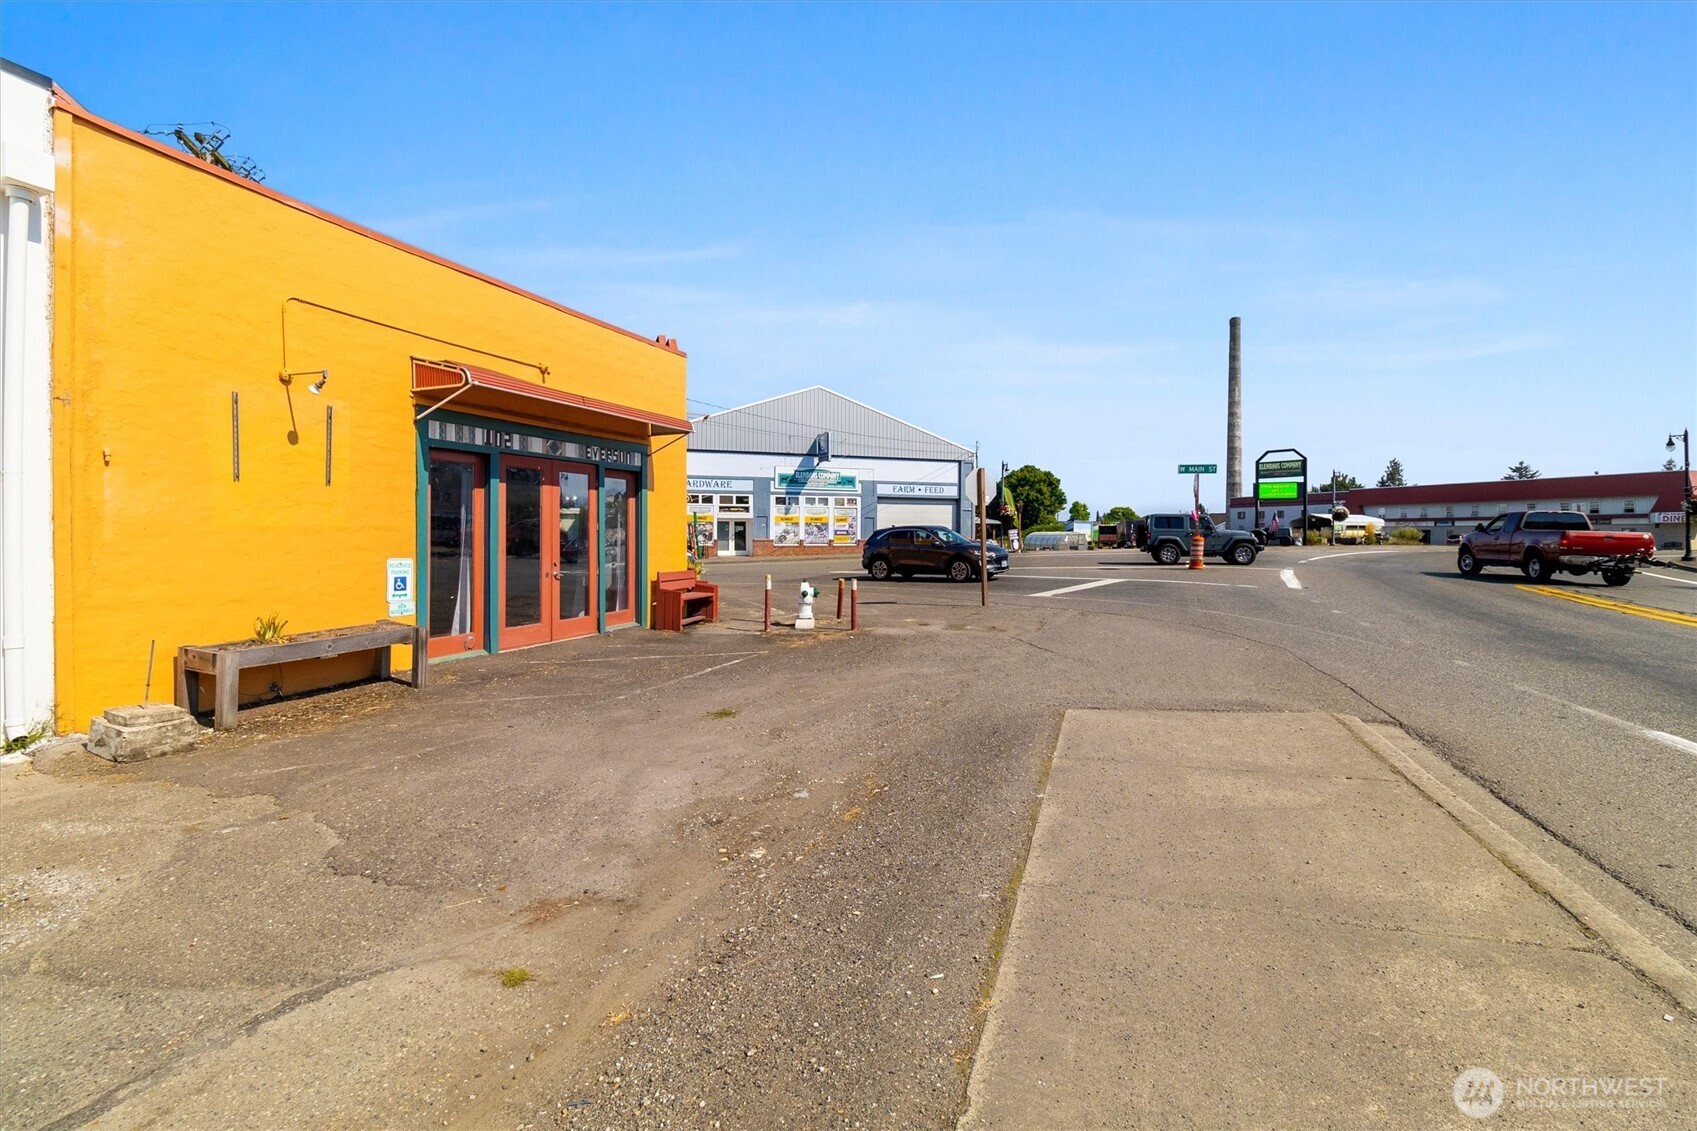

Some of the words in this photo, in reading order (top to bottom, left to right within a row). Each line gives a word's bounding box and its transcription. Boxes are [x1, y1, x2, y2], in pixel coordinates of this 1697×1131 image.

[1281, 461, 1302, 469] COMPANY
[687, 480, 733, 488] ARDWARE
[892, 485, 915, 493] FARM
[924, 486, 945, 494] FEED
